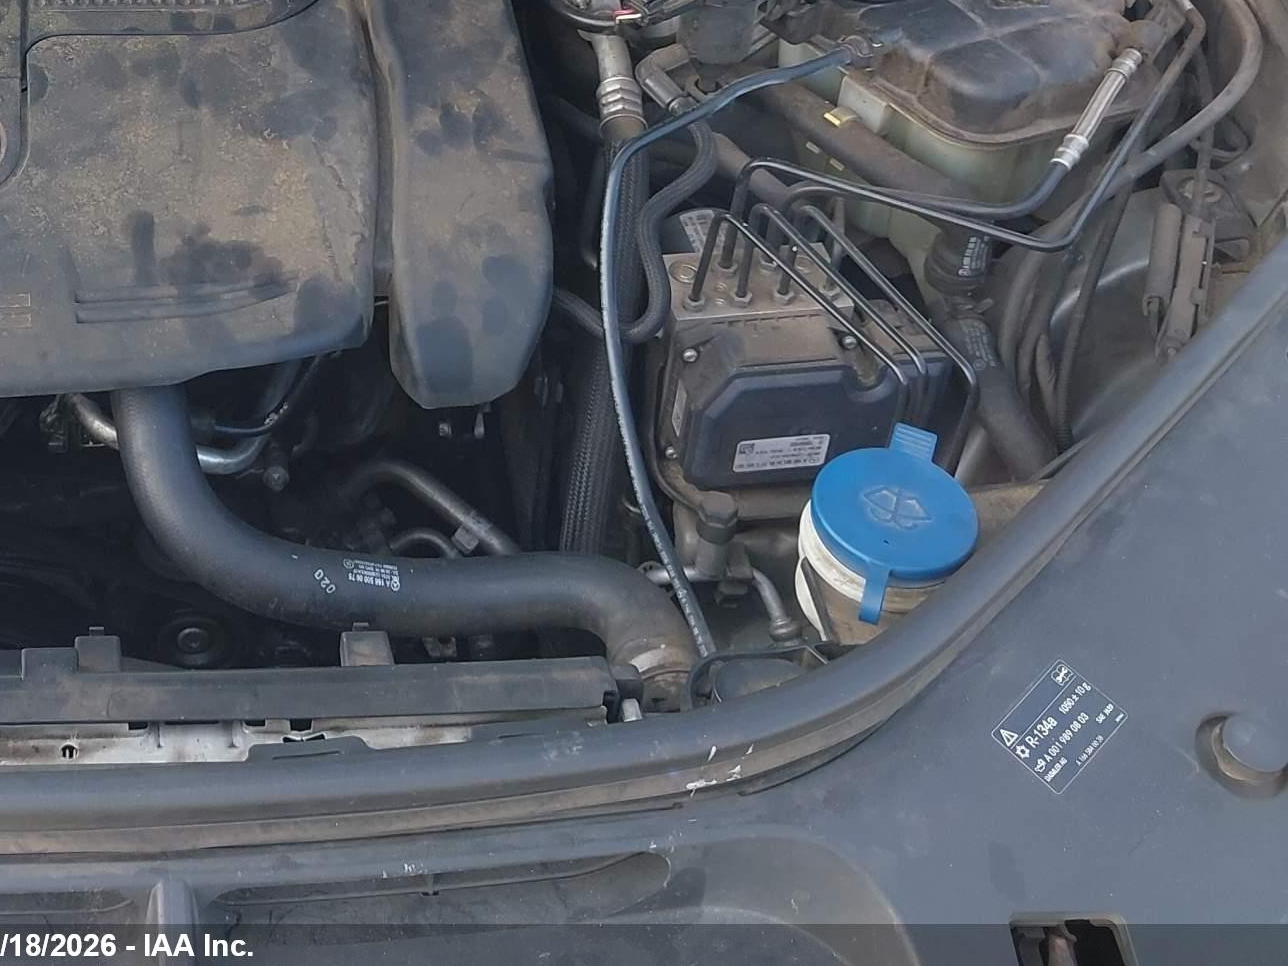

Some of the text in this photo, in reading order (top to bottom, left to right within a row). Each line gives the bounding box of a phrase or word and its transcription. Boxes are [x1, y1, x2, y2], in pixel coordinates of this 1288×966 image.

[314, 569, 336, 594] 020
[1025, 716, 1058, 748] R-134a
[1043, 712, 1089, 763] A 001 989 08 03
